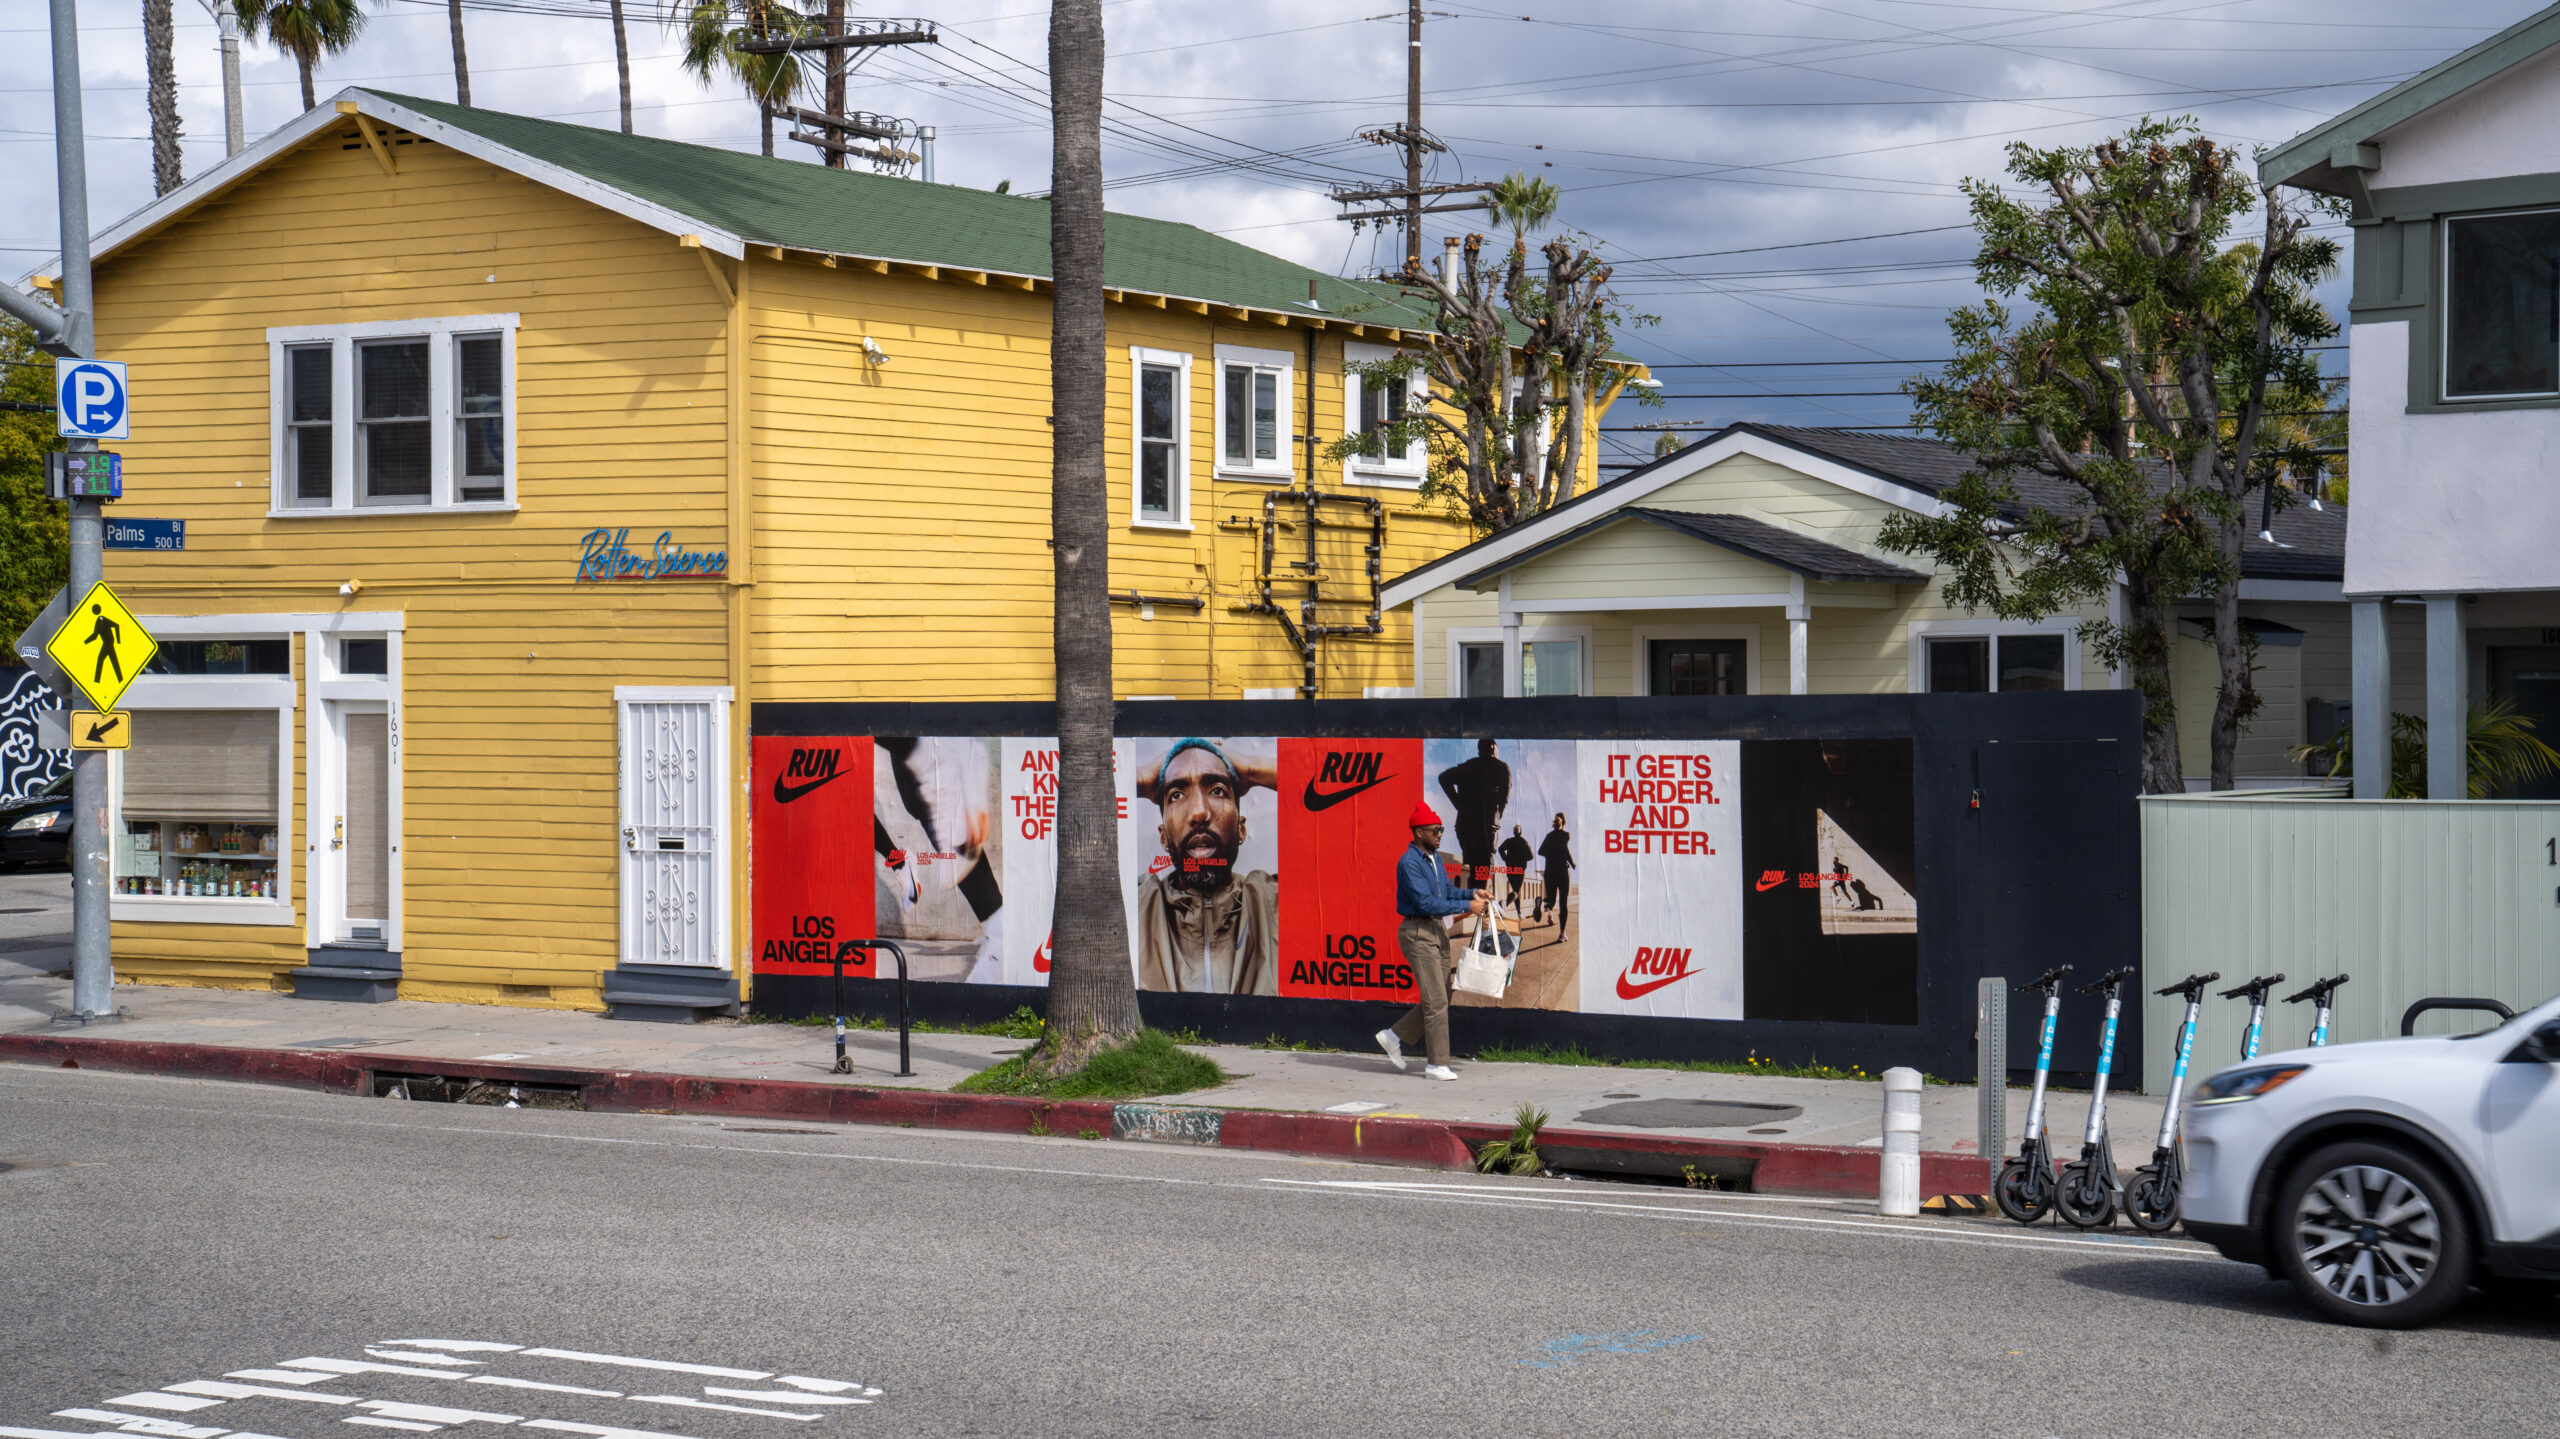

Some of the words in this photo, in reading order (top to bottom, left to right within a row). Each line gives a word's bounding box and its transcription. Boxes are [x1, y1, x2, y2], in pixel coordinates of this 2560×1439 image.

[75, 371, 115, 426] P
[87, 455, 111, 473] 19
[87, 476, 111, 494] 11
[107, 525, 145, 541] Palms
[172, 521, 181, 533] Bl
[154, 536, 173, 548] 500
[176, 537, 182, 548] E
[576, 528, 646, 582] Rotten
[644, 531, 728, 579] Science
[391, 702, 399, 765] 1601
[787, 749, 841, 777] RUN
[1319, 752, 1384, 784] RUN
[1608, 755, 1631, 778] IT
[1636, 755, 1712, 779] GETS
[1599, 779, 1720, 804] HARDER.
[1011, 796, 1056, 817] THE
[1629, 805, 1690, 829] AND
[1021, 818, 1052, 841] OF
[889, 849, 907, 859] RUN
[1604, 829, 1716, 855] BETTER.
[929, 852, 957, 860] ANGELES
[1153, 855, 1173, 866] RUN
[1183, 857, 1196, 865] LOS
[1197, 858, 1228, 866] ANGELES
[1475, 873, 1493, 881] 2024
[1490, 867, 1524, 875] ANGELES
[1761, 870, 1786, 882] RUN
[1798, 873, 1816, 881] LOS
[1817, 873, 1853, 881] ANGELES
[1799, 880, 1819, 888] 2024
[792, 915, 835, 939] LOS
[1325, 934, 1376, 960] LOS
[1630, 946, 1692, 976] RUN
[1289, 960, 1413, 990] ANGELES
[2042, 1025, 2055, 1060] BIRD
[2103, 1028, 2115, 1063] BIRD
[2180, 1032, 2194, 1068] BIRD
[2248, 1034, 2260, 1060] IRD
